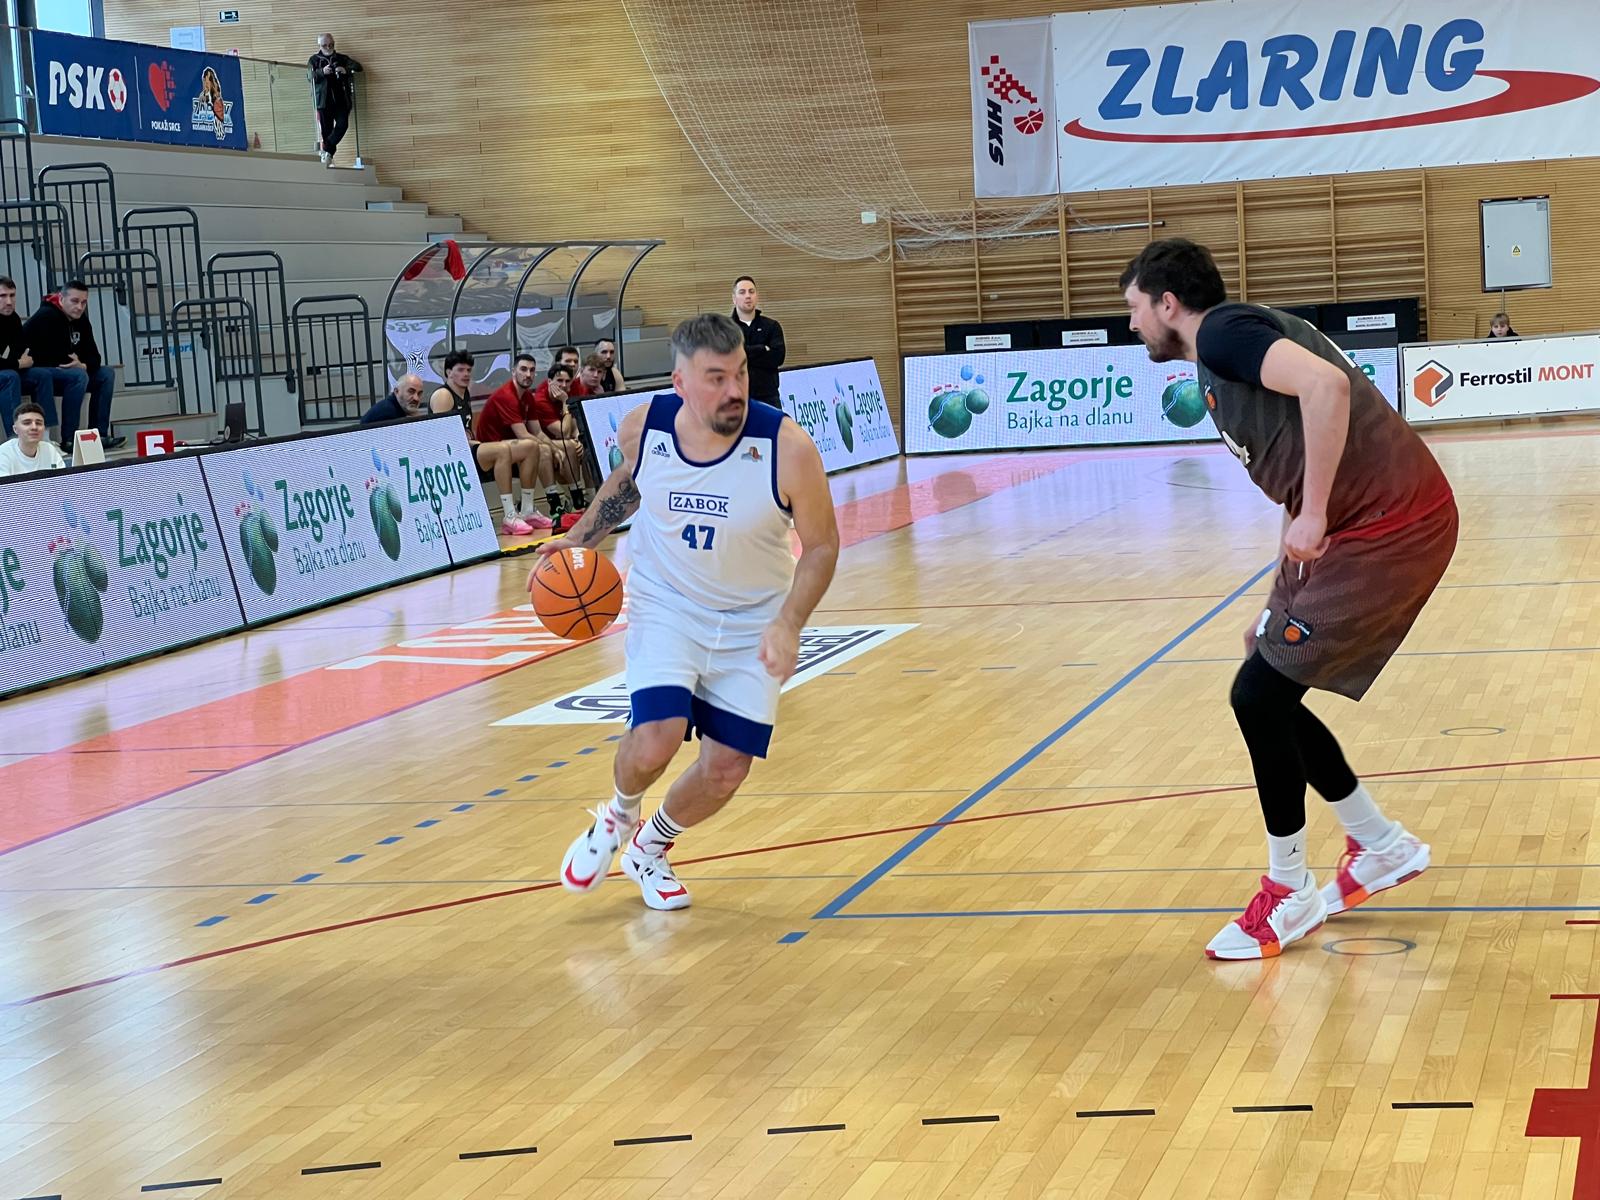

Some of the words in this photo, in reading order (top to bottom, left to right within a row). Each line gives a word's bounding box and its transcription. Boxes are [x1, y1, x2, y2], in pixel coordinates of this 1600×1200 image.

[49, 60, 106, 110] PSK
[1098, 18, 1485, 121] ZLARING
[151, 119, 169, 131] POKAŽI
[168, 121, 181, 132] SRCE
[987, 98, 1004, 167] HKS
[1006, 364, 1134, 411] Zagorje
[1460, 367, 1532, 387] Ferrostil
[1537, 364, 1595, 382] MONT
[788, 387, 829, 437] Zagorje
[848, 378, 883, 424] Zagorje
[1007, 411, 1052, 434] Bajka
[1059, 415, 1080, 428] na
[1085, 406, 1134, 427] dlanu
[399, 444, 472, 515] Zagorje
[275, 466, 355, 543] Zagorje
[415, 512, 442, 550] Bajka
[443, 518, 457, 536] na
[456, 505, 483, 533] dlanu
[673, 496, 728, 513] ZABOK
[106, 492, 208, 580] Zagorje
[293, 541, 326, 580] Bajka
[324, 547, 339, 567] na
[339, 534, 367, 564] dlanu
[681, 524, 715, 550] 47
[128, 578, 171, 624] Bajka
[171, 585, 189, 608] na
[187, 568, 222, 603] dlanu
[0, 612, 42, 652] lanu
